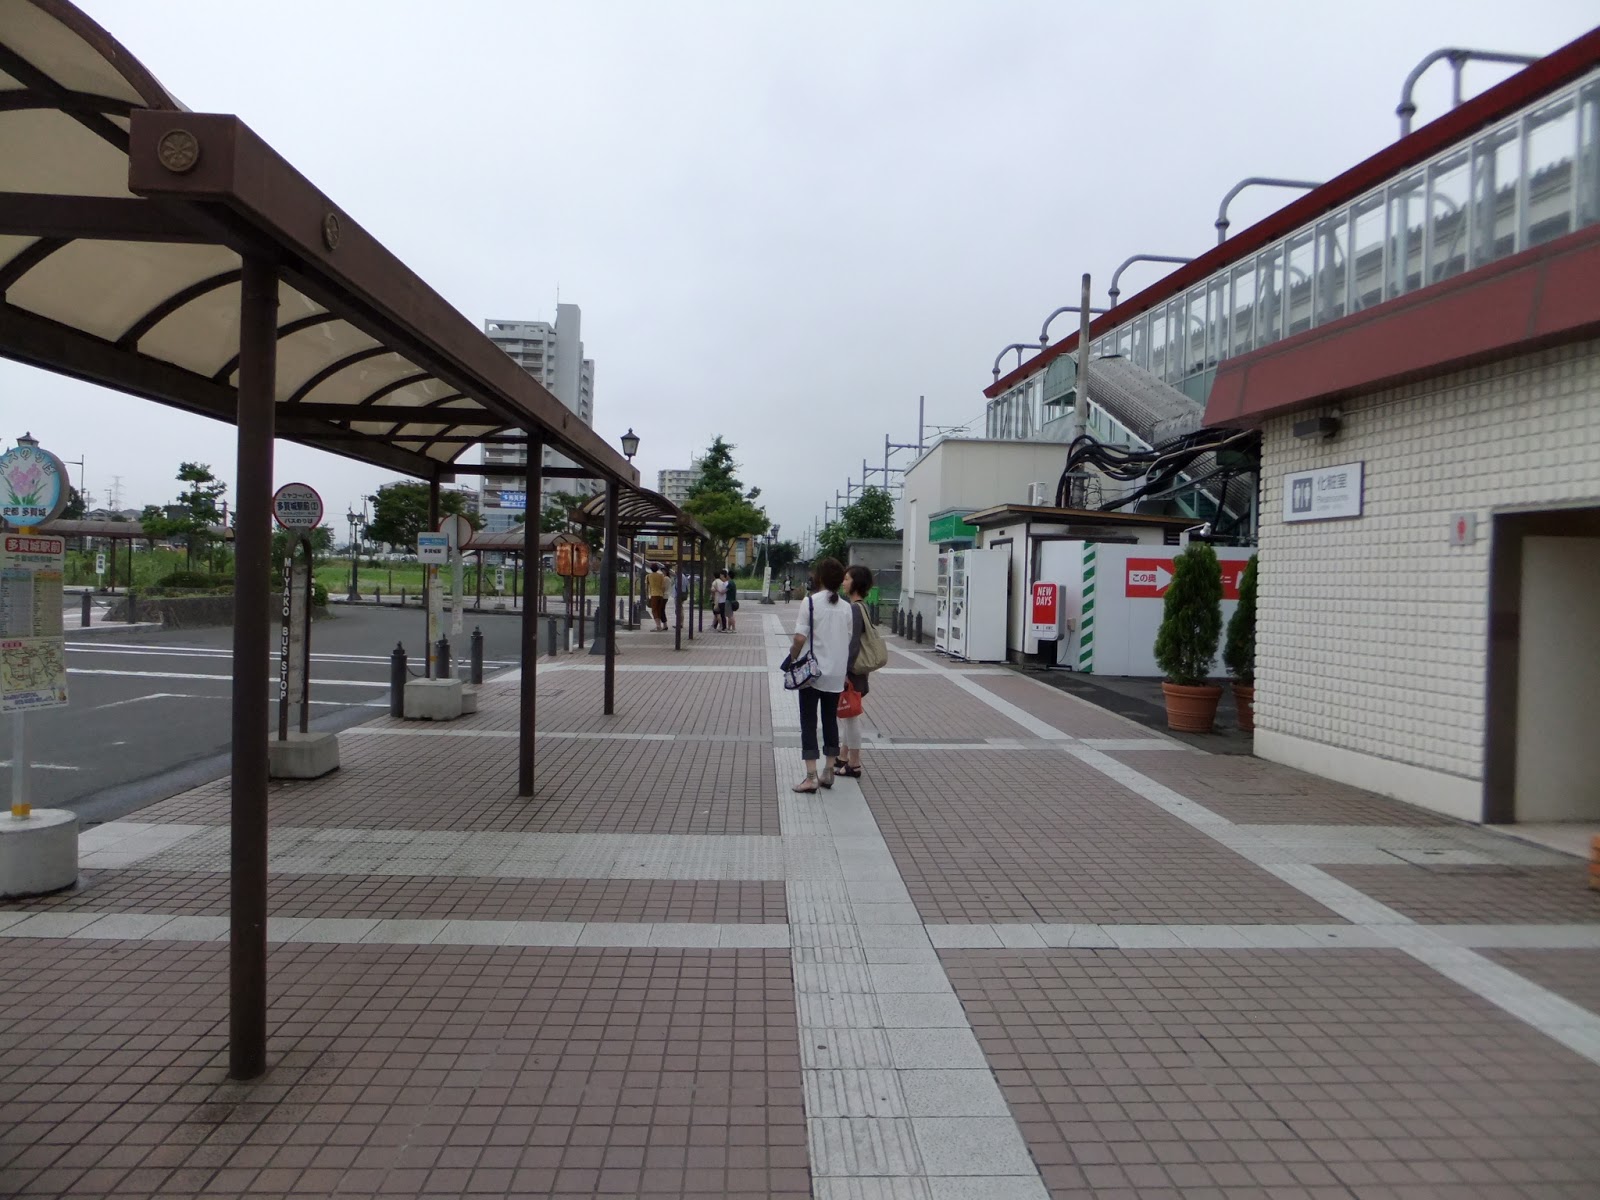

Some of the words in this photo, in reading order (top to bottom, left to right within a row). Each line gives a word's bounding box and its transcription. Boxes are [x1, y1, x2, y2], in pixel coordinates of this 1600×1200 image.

[22, 507, 47, 517] 多賀城
[7, 541, 61, 554] 多賀城駅前
[1132, 573, 1157, 583] この奥
[282, 557, 292, 617] MIYAKO
[1037, 586, 1054, 597] NEW
[1036, 597, 1053, 606] DAYS
[281, 627, 289, 656] BUS
[280, 660, 288, 700] STOP
